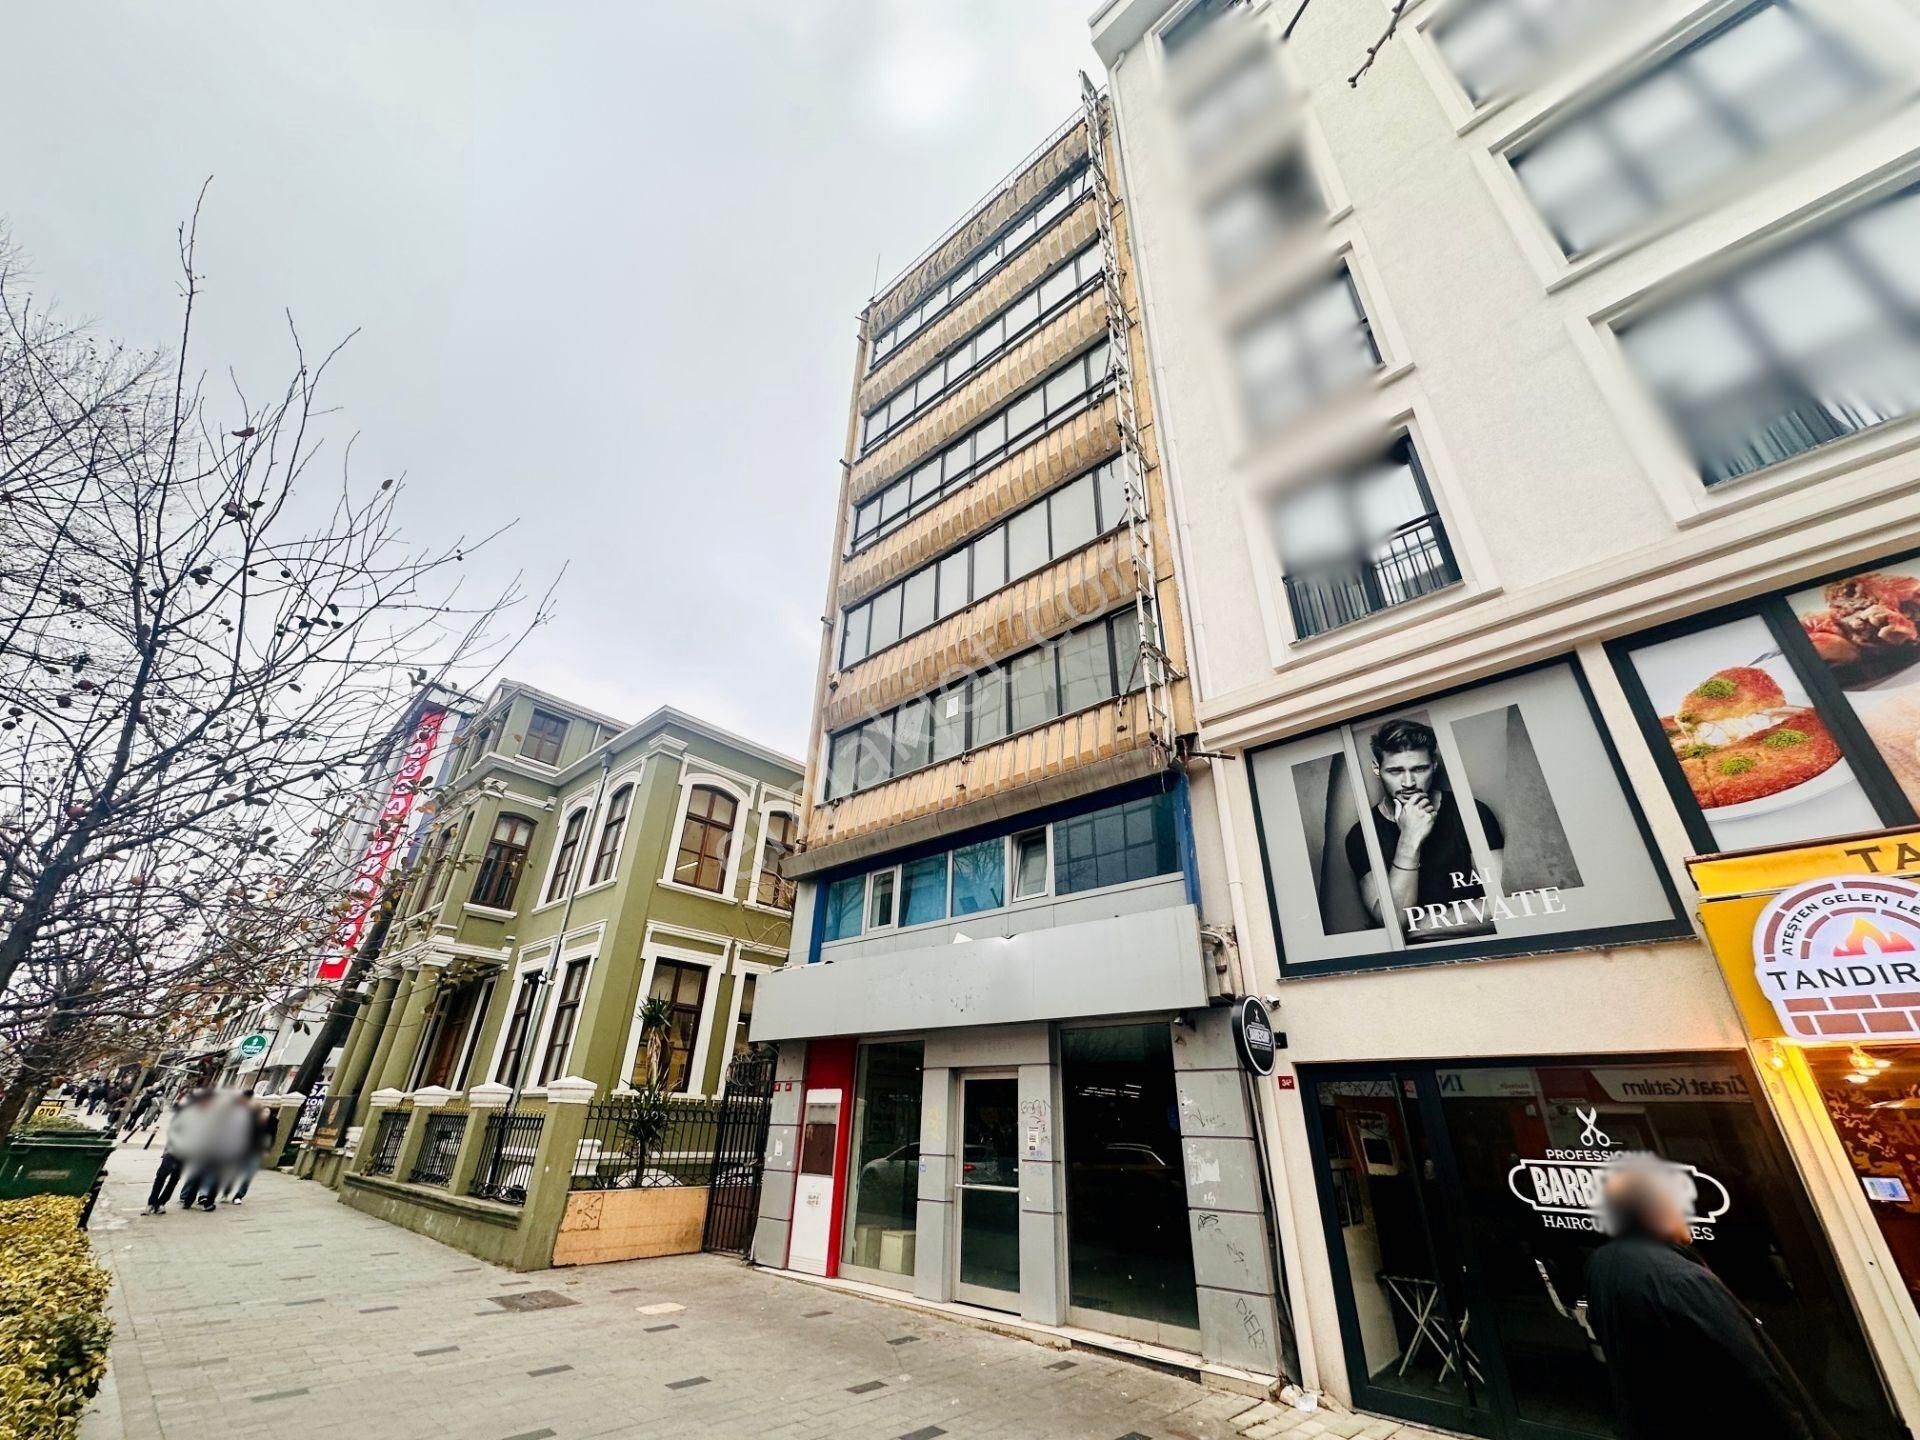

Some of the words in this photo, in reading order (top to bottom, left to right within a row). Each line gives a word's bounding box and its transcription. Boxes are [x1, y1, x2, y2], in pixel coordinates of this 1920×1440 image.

[1403, 886, 1566, 932] PRIVATE
[1782, 902, 1819, 956] ATEŞTEN
[1822, 893, 1888, 906] GELEN
